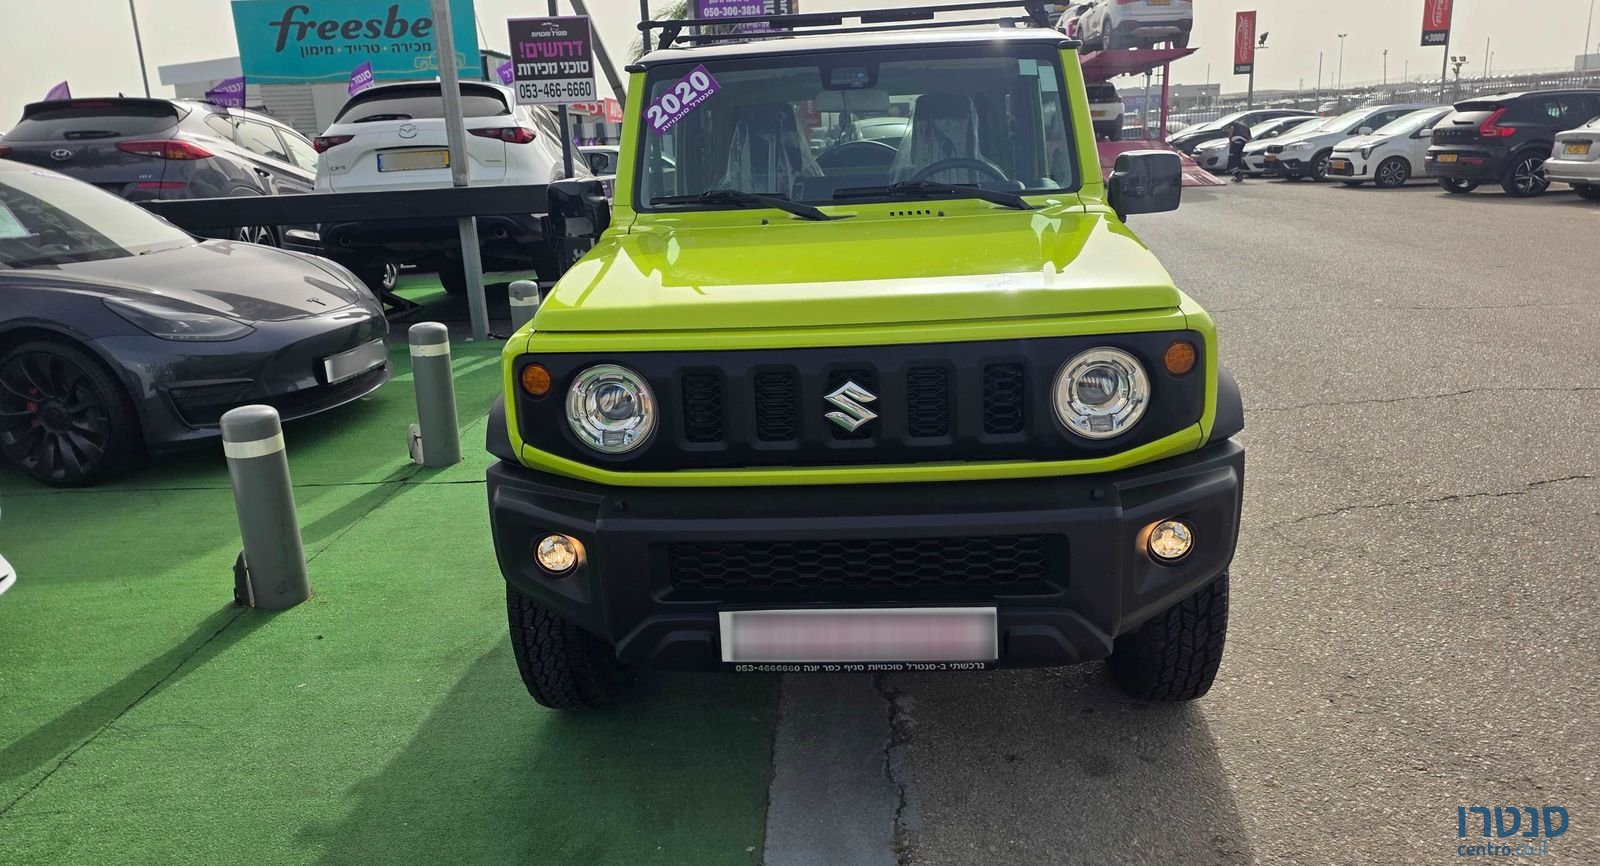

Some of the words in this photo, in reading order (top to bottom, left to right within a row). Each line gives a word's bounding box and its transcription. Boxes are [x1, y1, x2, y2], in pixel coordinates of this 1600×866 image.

[703, 6, 761, 18] 050-300-3824
[269, 4, 432, 53] freesbe
[300, 45, 335, 59] מימון
[343, 43, 381, 55] טרייד
[391, 42, 432, 54] מכירה
[519, 40, 584, 59] דרושים!
[517, 62, 558, 77] מכירות
[560, 60, 590, 75] סוכני
[519, 81, 592, 99] 053-466-6660
[647, 71, 710, 129] 2020
[689, 88, 715, 108] סנטרל
[661, 107, 690, 132] סוכנויות
[735, 664, 801, 673] 053-4666660
[803, 664, 820, 673] יונה
[822, 664, 841, 672] כפר
[843, 663, 865, 673] סניף
[867, 663, 903, 671] סוכנויות
[906, 662, 947, 671] ב-סנטרל
[949, 662, 985, 671] נרכשתי
